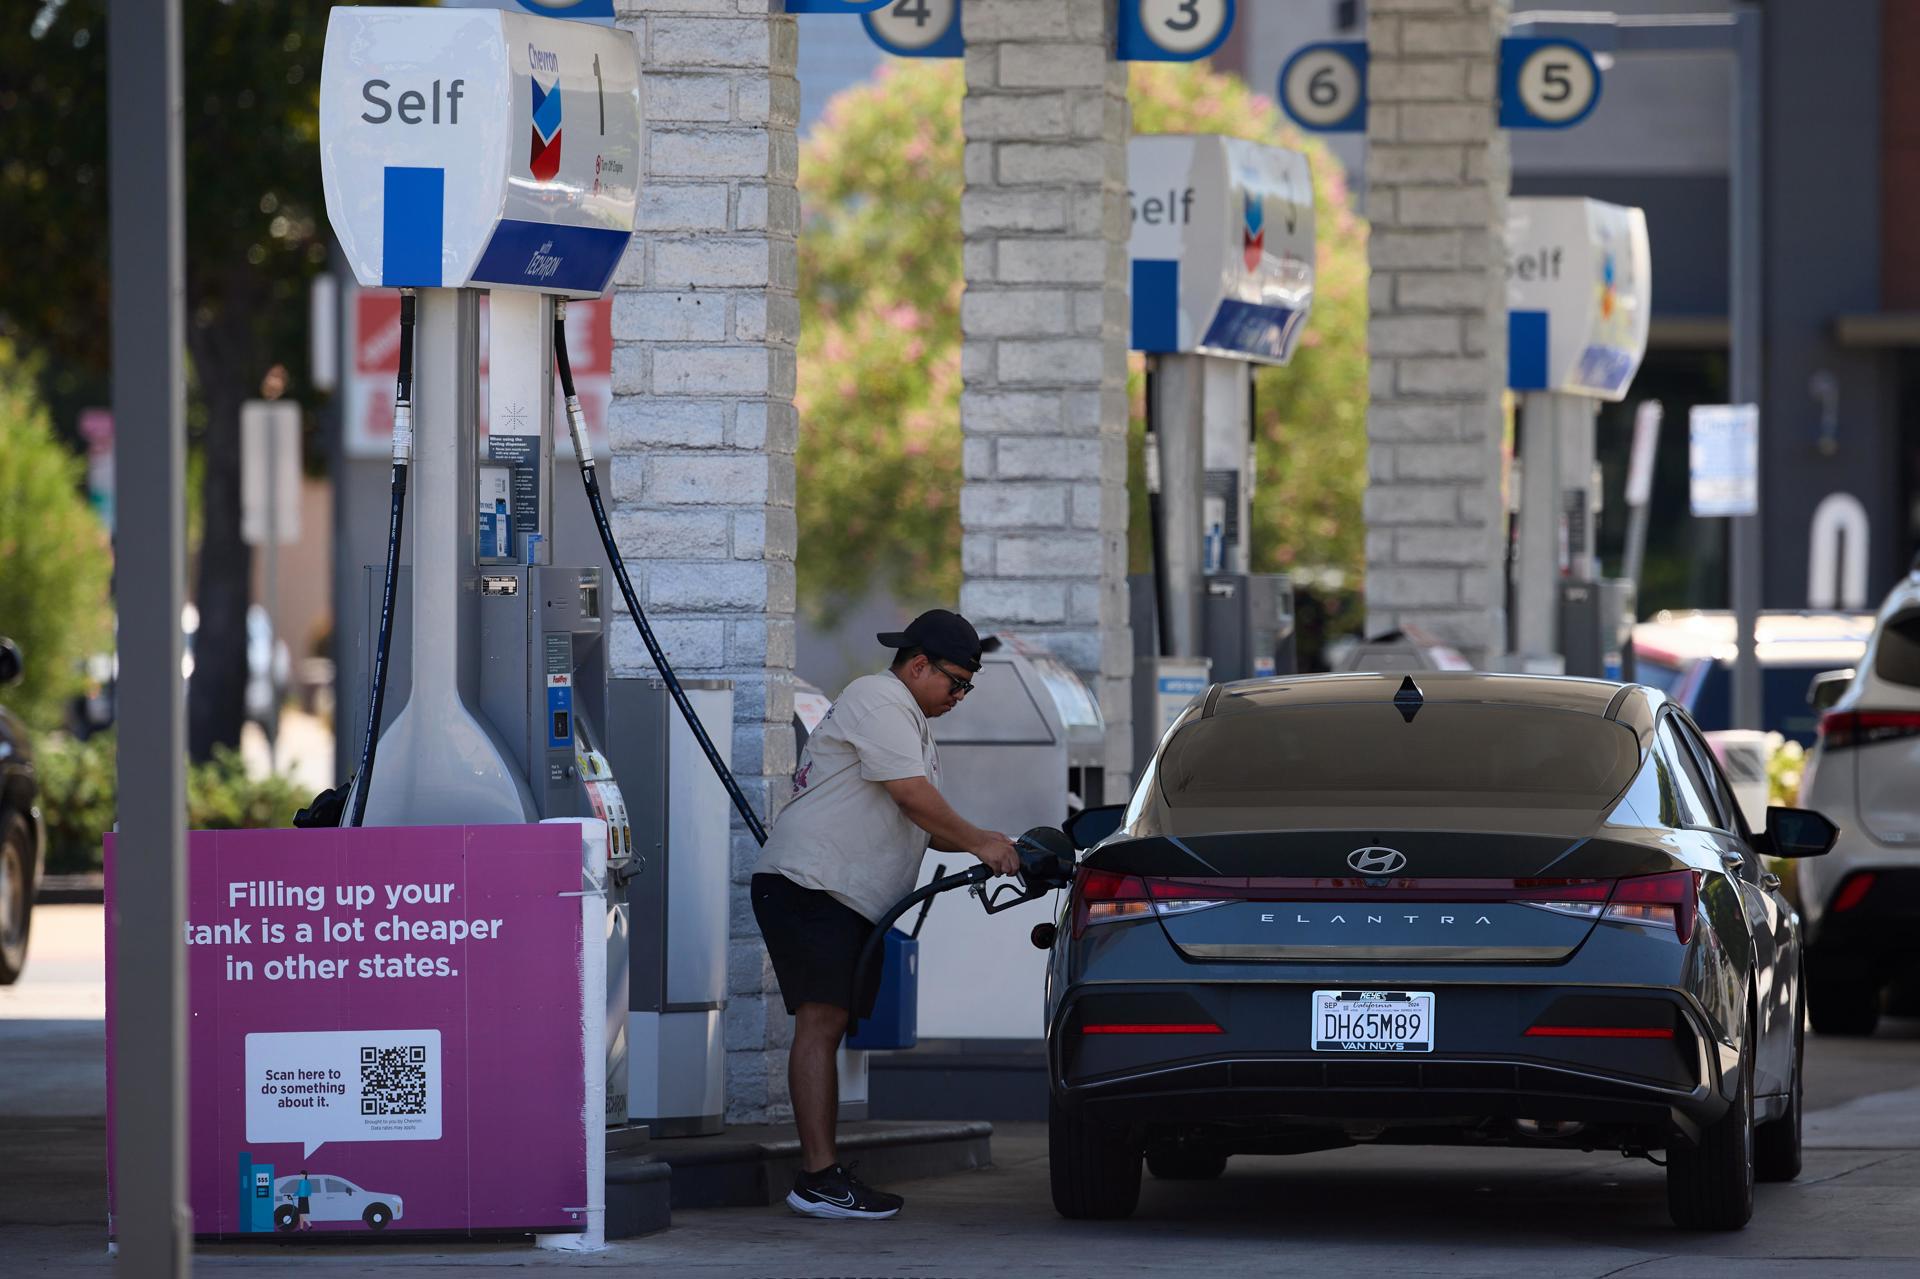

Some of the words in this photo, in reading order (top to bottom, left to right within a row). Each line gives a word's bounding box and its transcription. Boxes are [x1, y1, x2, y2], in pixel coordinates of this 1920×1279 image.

[891, 0, 931, 27] 4
[1164, 0, 1199, 32] 3
[528, 42, 559, 73] Chevron
[1308, 66, 1338, 107] 6
[1542, 64, 1572, 103] 5
[361, 79, 464, 124] Self
[229, 881, 325, 911] Filling
[336, 884, 375, 910] up
[385, 883, 455, 909] your
[184, 918, 252, 945] tank
[262, 918, 286, 943] is
[295, 922, 312, 943] a
[323, 916, 365, 942] lot
[374, 915, 503, 944] cheaper
[1261, 914, 1491, 925] ELANTRA
[226, 955, 254, 981] in
[264, 954, 349, 980] other
[358, 953, 458, 979] states.
[1353, 1001, 1392, 1011] California
[1325, 1014, 1421, 1039] DH65M89
[1341, 1042, 1366, 1050] VAN
[1370, 1042, 1405, 1050] NUYS
[265, 1069, 295, 1080] Scan
[298, 1068, 325, 1080] here
[328, 1069, 341, 1079] to
[261, 1083, 277, 1094] do
[280, 1082, 345, 1095] something
[278, 1096, 314, 1108] about
[317, 1095, 329, 1107] it.
